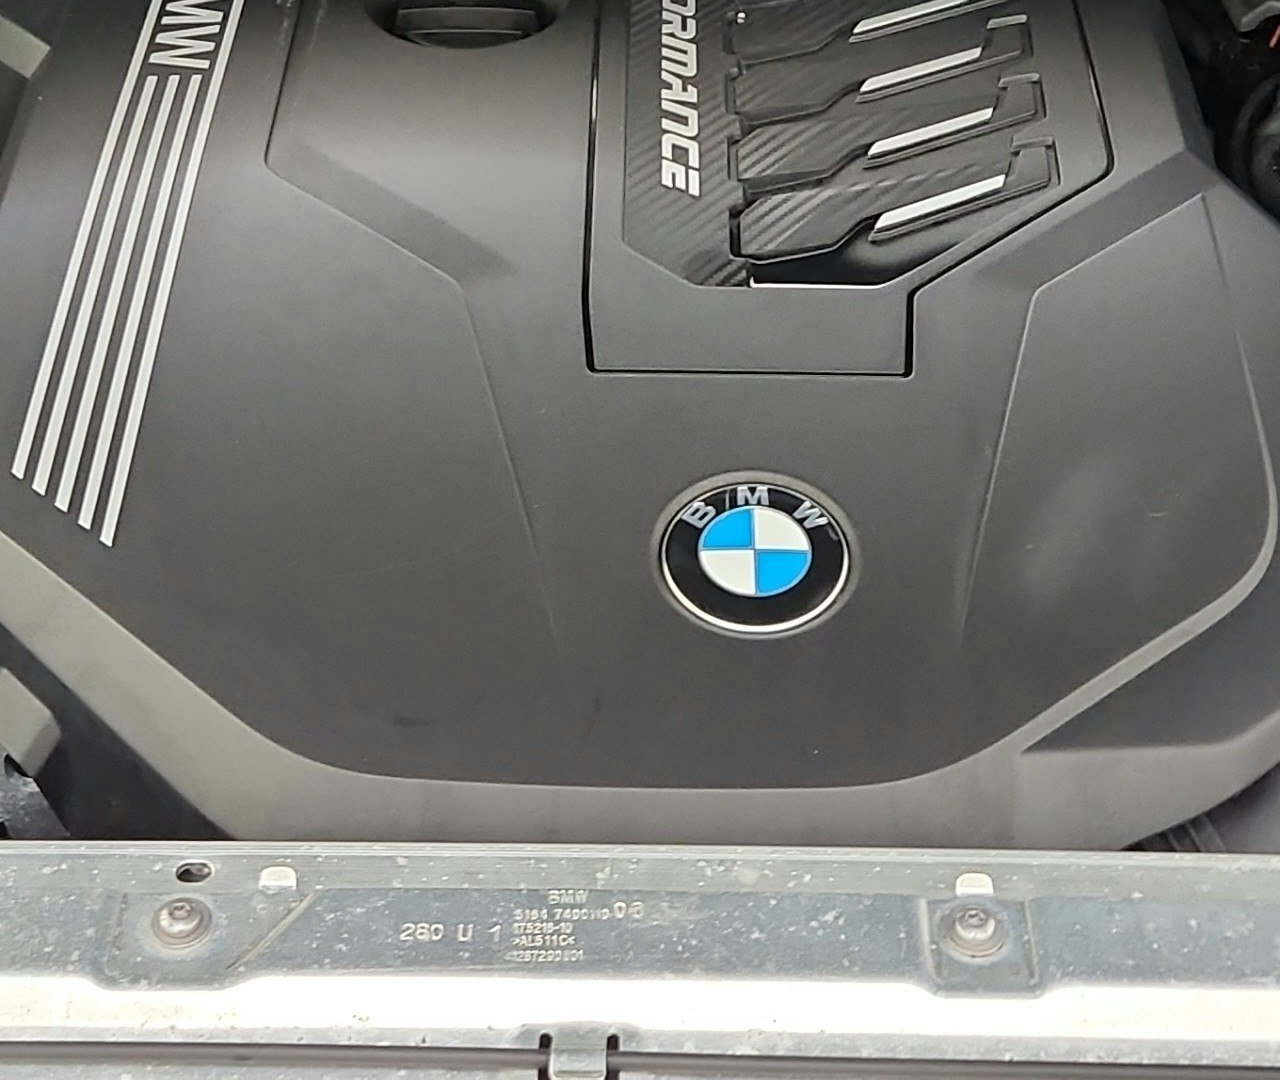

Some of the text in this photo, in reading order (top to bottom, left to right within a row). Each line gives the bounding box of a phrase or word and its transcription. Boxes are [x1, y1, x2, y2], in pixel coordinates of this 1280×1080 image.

[681, 486, 830, 530] BMW
[548, 889, 588, 905] BMW
[399, 922, 502, 942] 280 U 1
